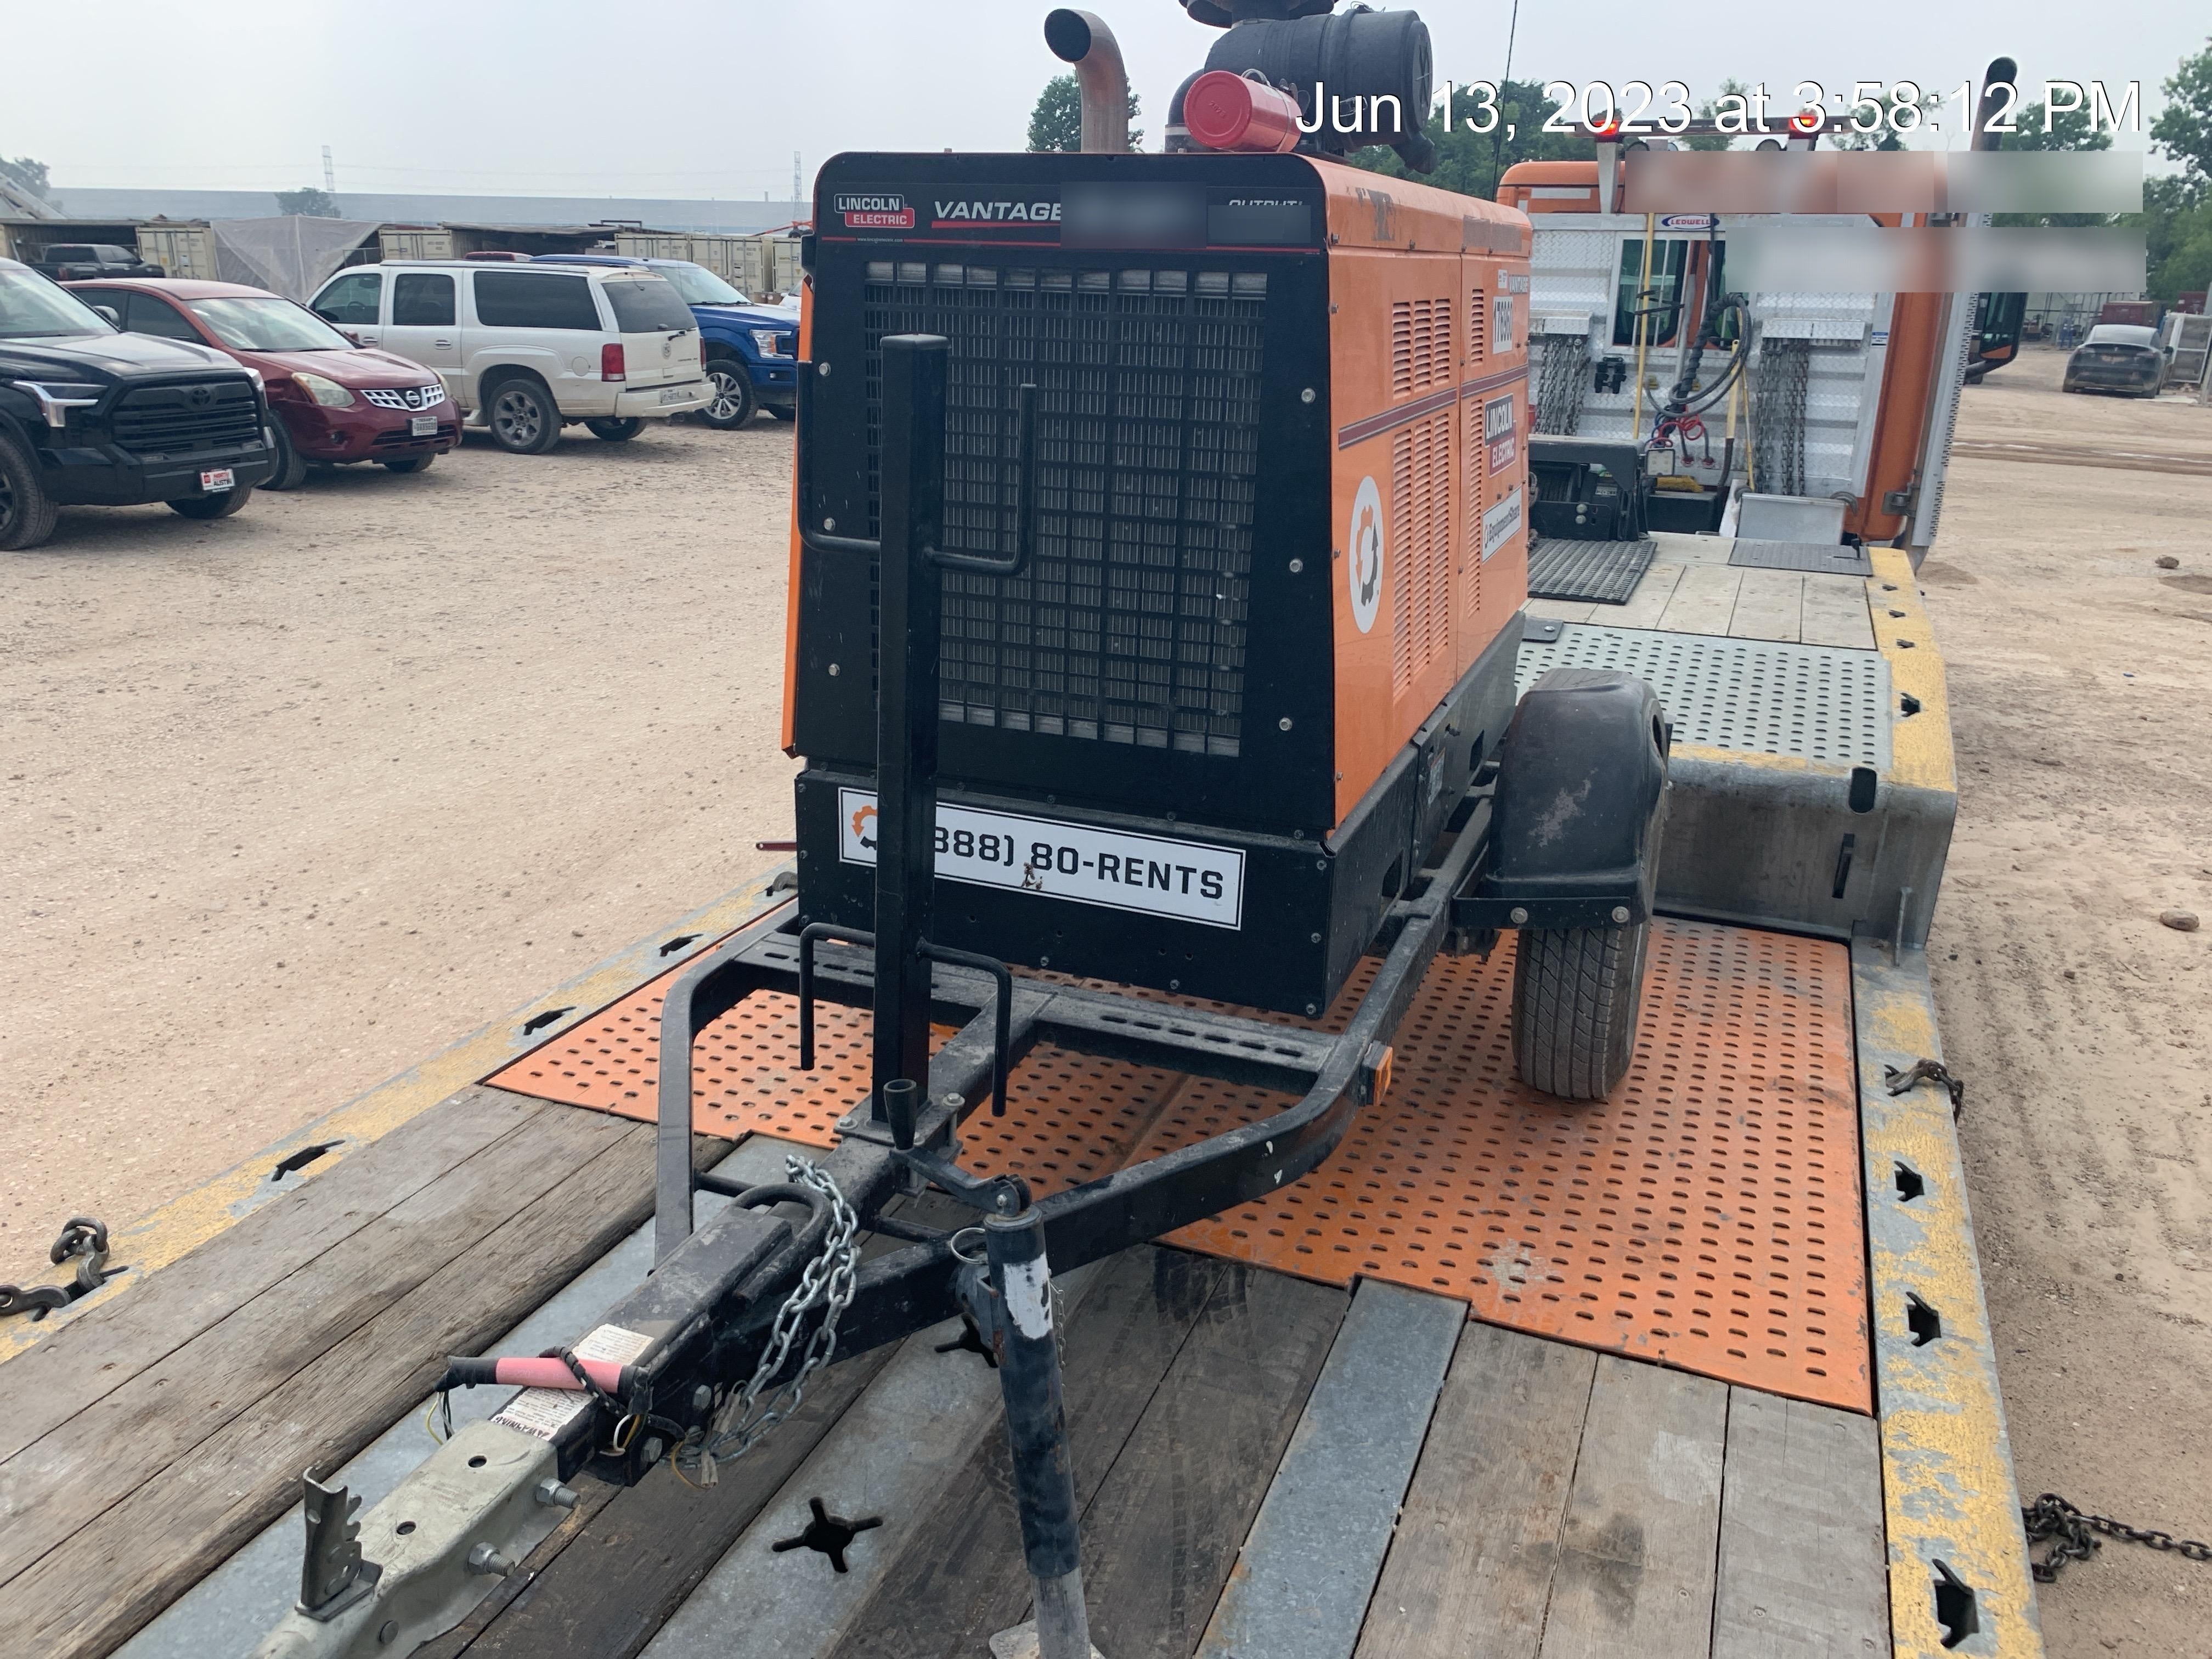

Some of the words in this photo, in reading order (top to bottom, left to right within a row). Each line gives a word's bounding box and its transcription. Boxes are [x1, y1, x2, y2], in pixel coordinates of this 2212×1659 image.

[838, 198, 900, 211] LINCOLN
[853, 214, 907, 225] ELECTRIC
[1509, 276, 1528, 292] VANTAGE
[1486, 402, 1513, 439] LINCOLN
[1492, 437, 1515, 468] ELECTRIC
[935, 827, 1014, 867] 888)
[1031, 842, 1224, 900] 80-RENTS
